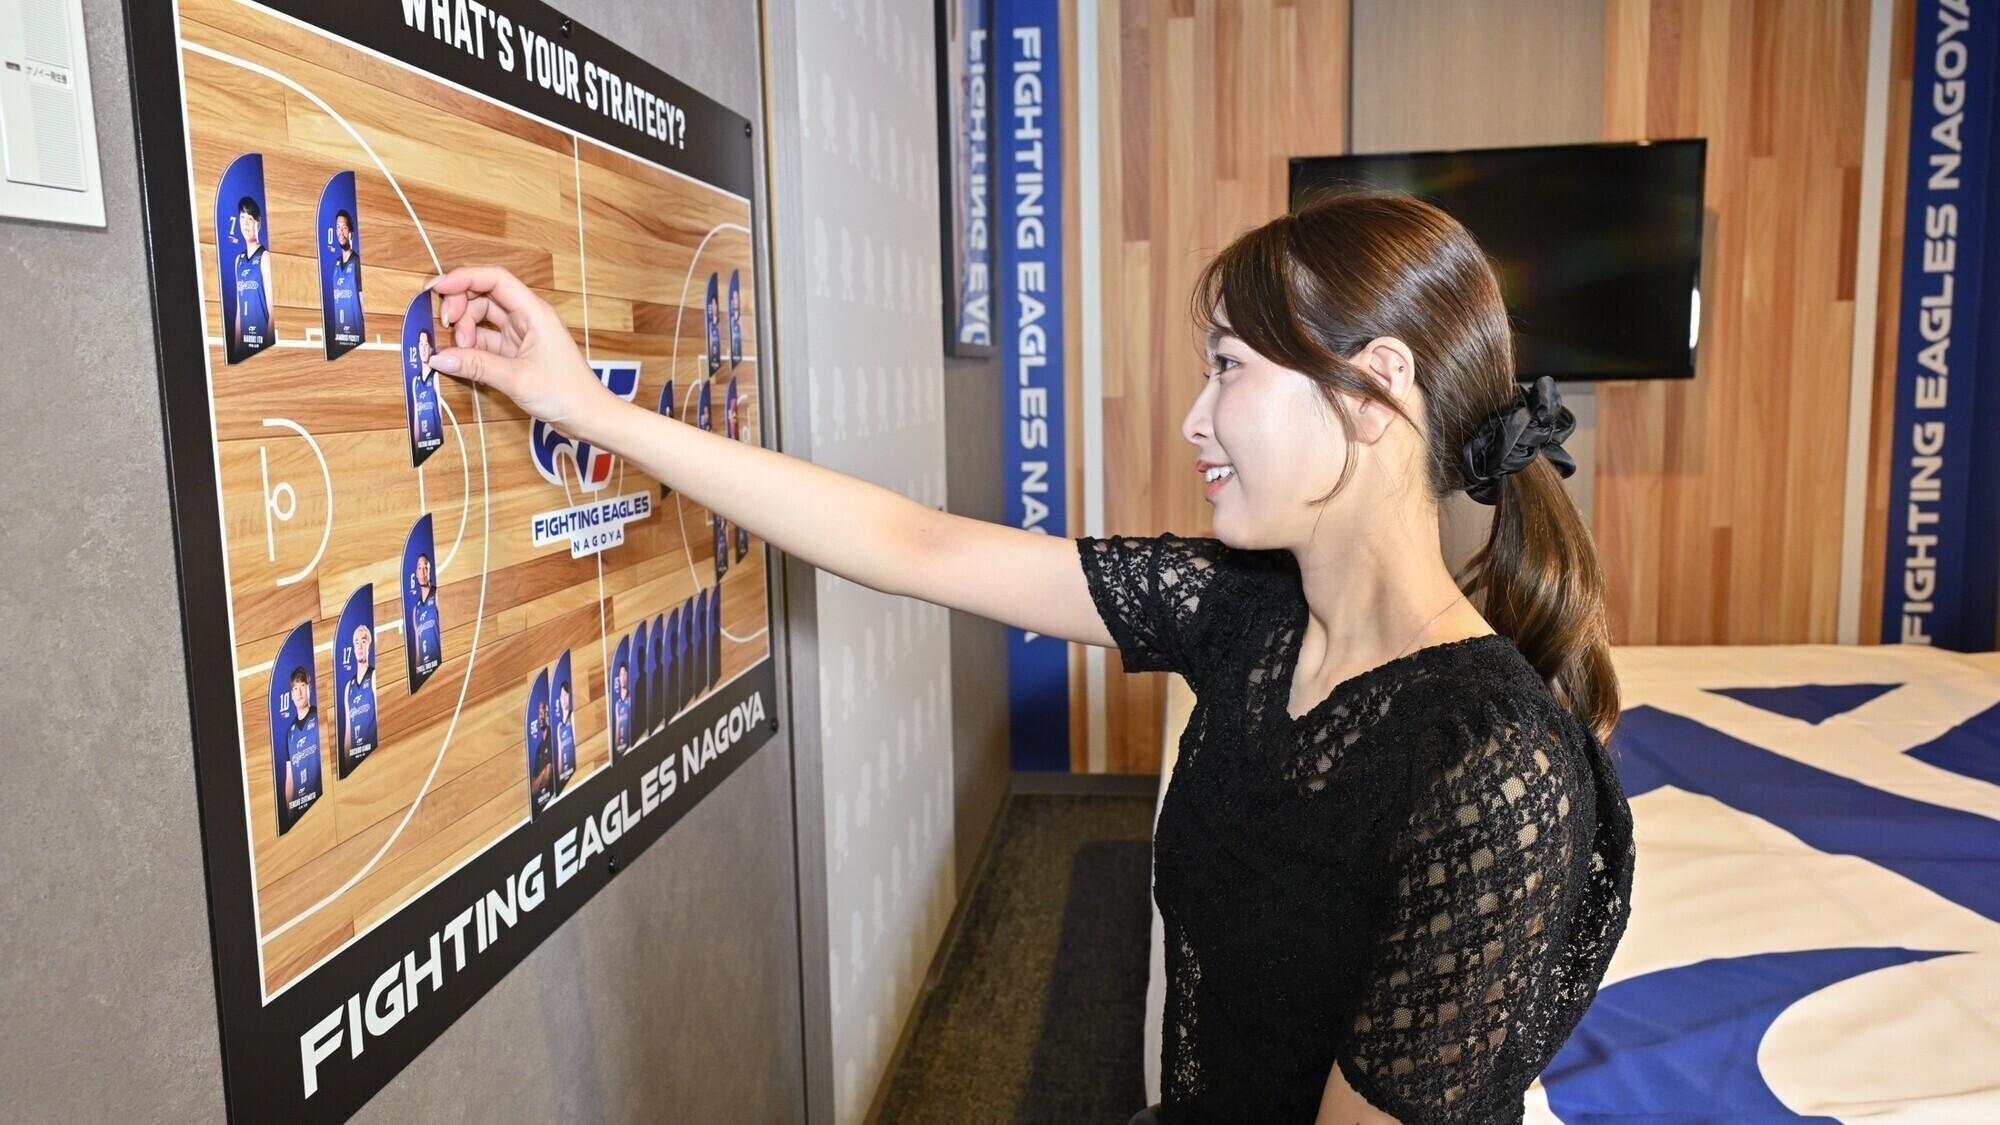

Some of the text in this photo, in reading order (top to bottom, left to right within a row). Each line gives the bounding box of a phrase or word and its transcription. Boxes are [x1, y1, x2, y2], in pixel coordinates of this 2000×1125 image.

[518, 24, 581, 103] YOUR
[584, 60, 686, 150] STRATEGY?
[1013, 27, 1044, 250] FIGHTING
[229, 216, 237, 235] 7
[1915, 203, 1958, 409] EAGLES
[409, 346, 417, 363] 12
[1017, 261, 1048, 449] EAGLES
[534, 496, 650, 541] FIGHTING EAGLES
[573, 529, 622, 553] NAGOYA
[1901, 421, 1945, 645] FIGHTING
[410, 573, 416, 590] 6
[343, 646, 352, 665] 17
[279, 692, 290, 713] 10
[300, 691, 766, 1100] FIGHTING EAGLES NAGOYA
